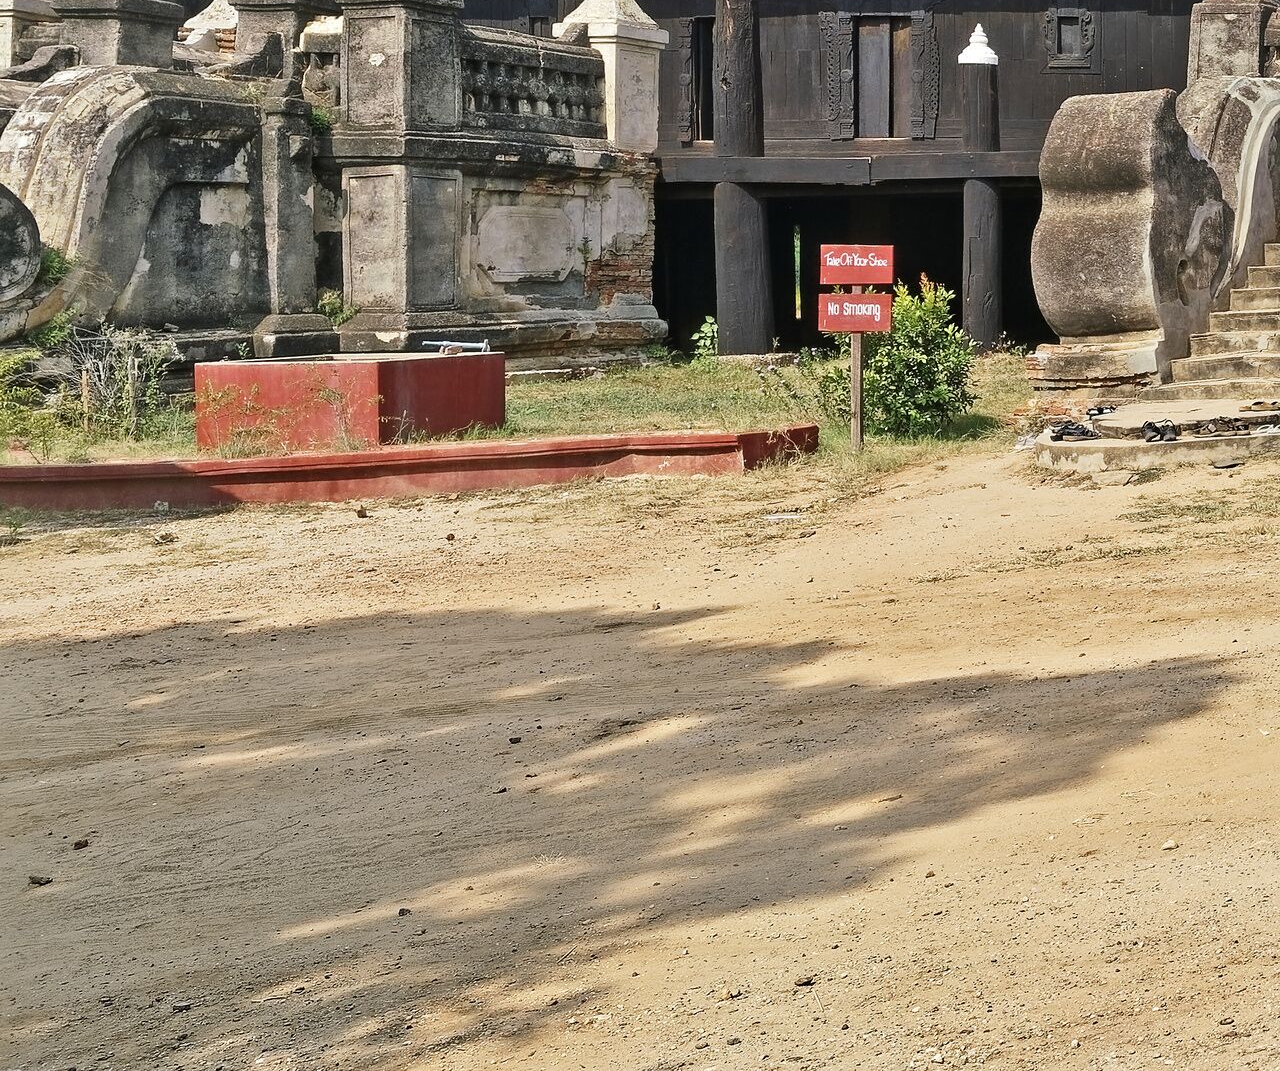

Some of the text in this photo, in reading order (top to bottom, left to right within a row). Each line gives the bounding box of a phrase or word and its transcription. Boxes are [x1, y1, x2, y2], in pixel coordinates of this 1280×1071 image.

[824, 251, 840, 266] Take
[828, 303, 880, 321] No Smoking
